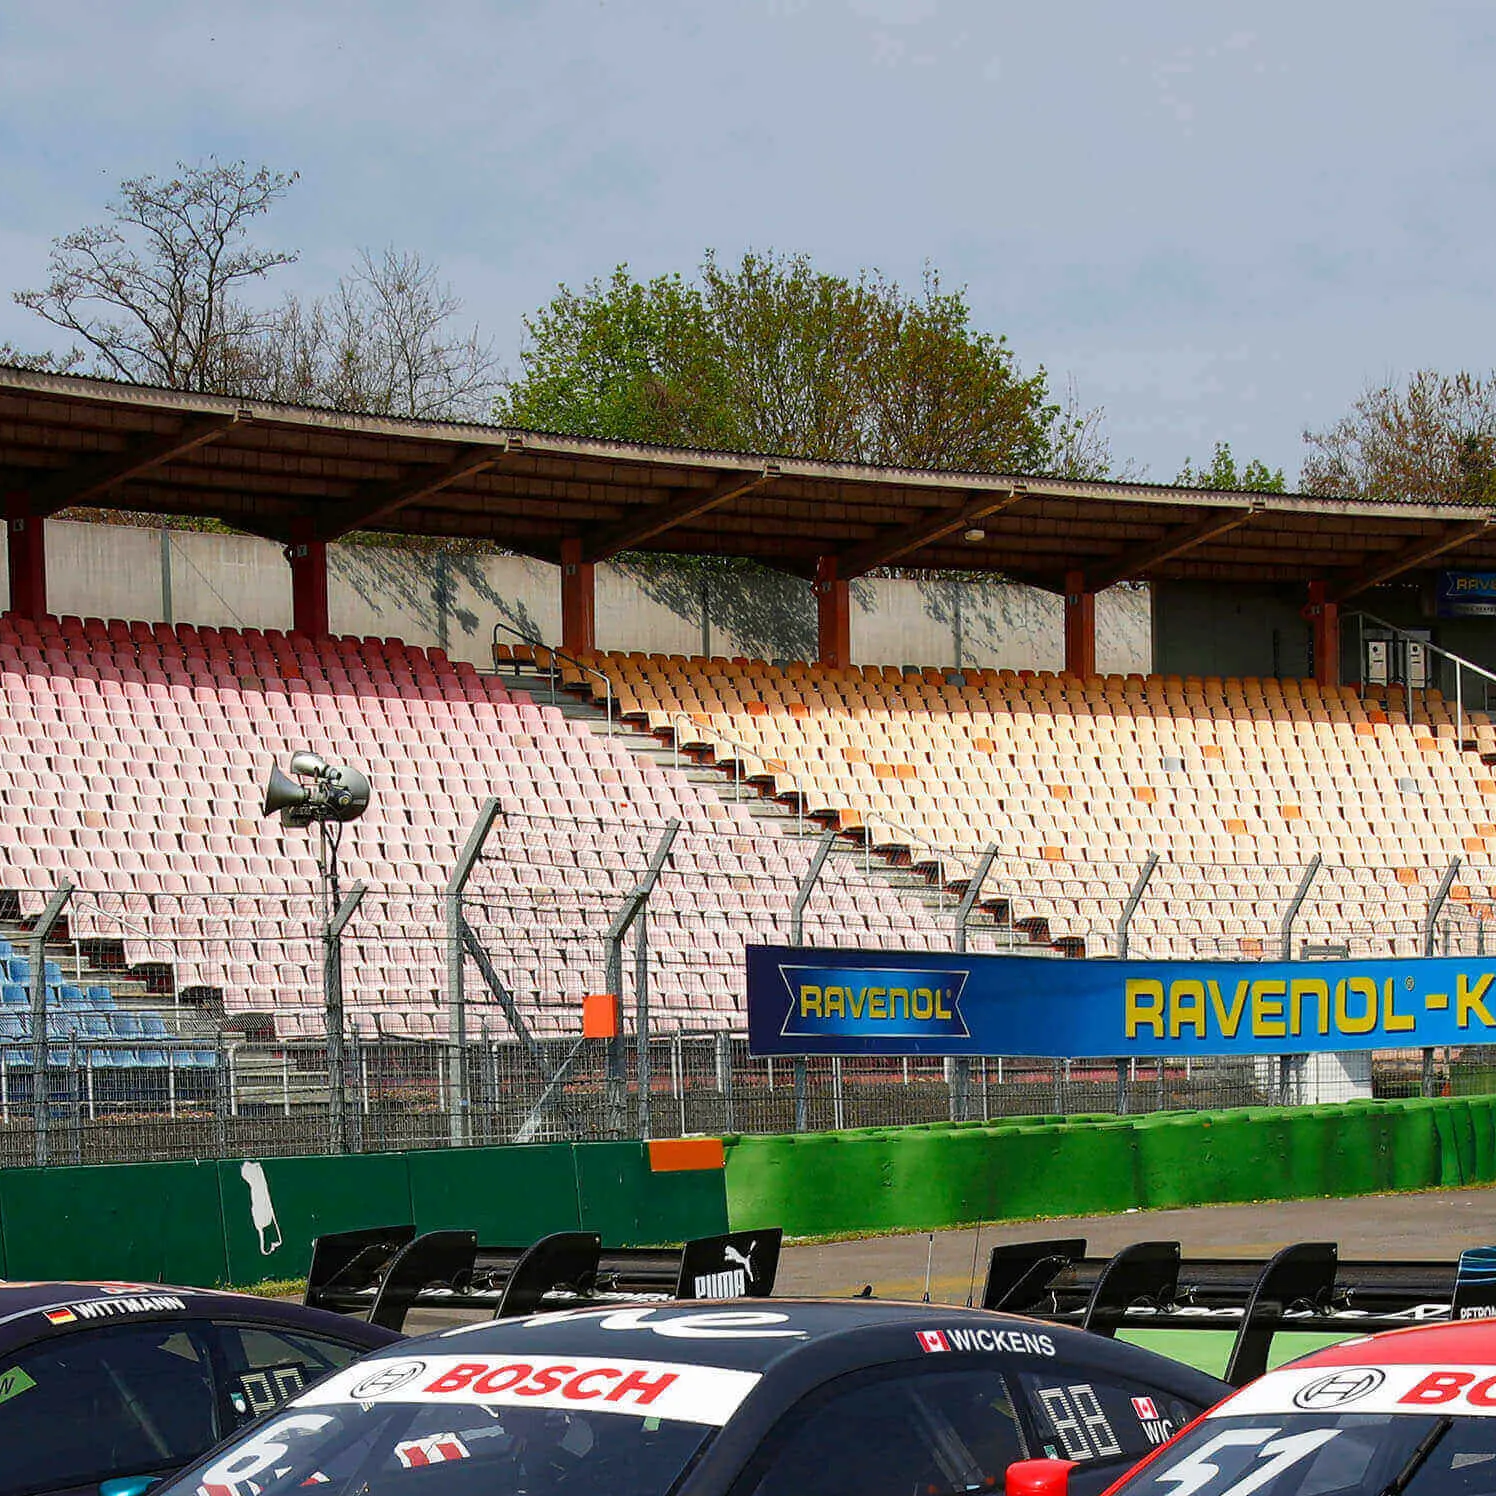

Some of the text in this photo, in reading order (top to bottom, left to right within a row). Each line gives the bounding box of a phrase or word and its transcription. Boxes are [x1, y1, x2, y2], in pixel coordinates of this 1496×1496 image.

[800, 985, 953, 1020] RAVENOL
[695, 1268, 745, 1299] PUMA
[73, 1296, 187, 1319] WITTMANN
[946, 1329, 1057, 1357] WICKENS
[422, 1363, 681, 1405] BOSCH
